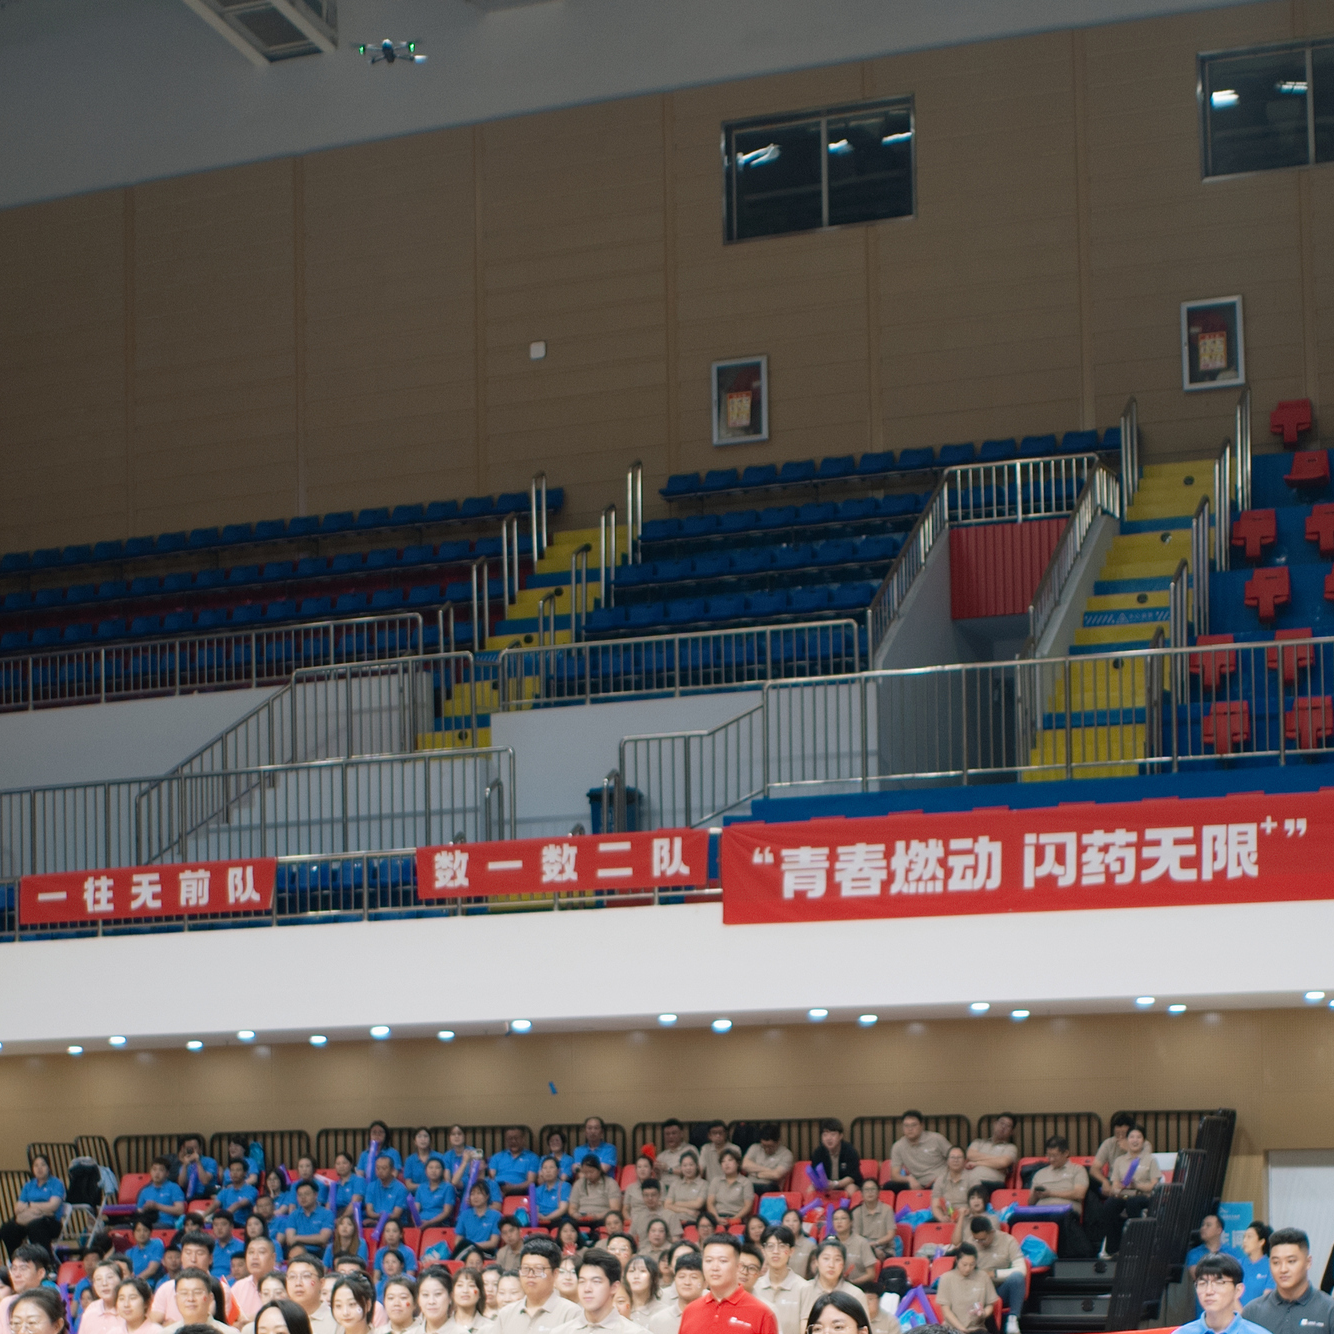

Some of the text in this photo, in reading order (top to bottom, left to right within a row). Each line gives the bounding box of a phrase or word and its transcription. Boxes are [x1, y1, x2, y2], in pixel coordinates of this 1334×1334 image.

[432, 835, 691, 890] 数一数二队
[37, 865, 261, 914] 一往无前队
